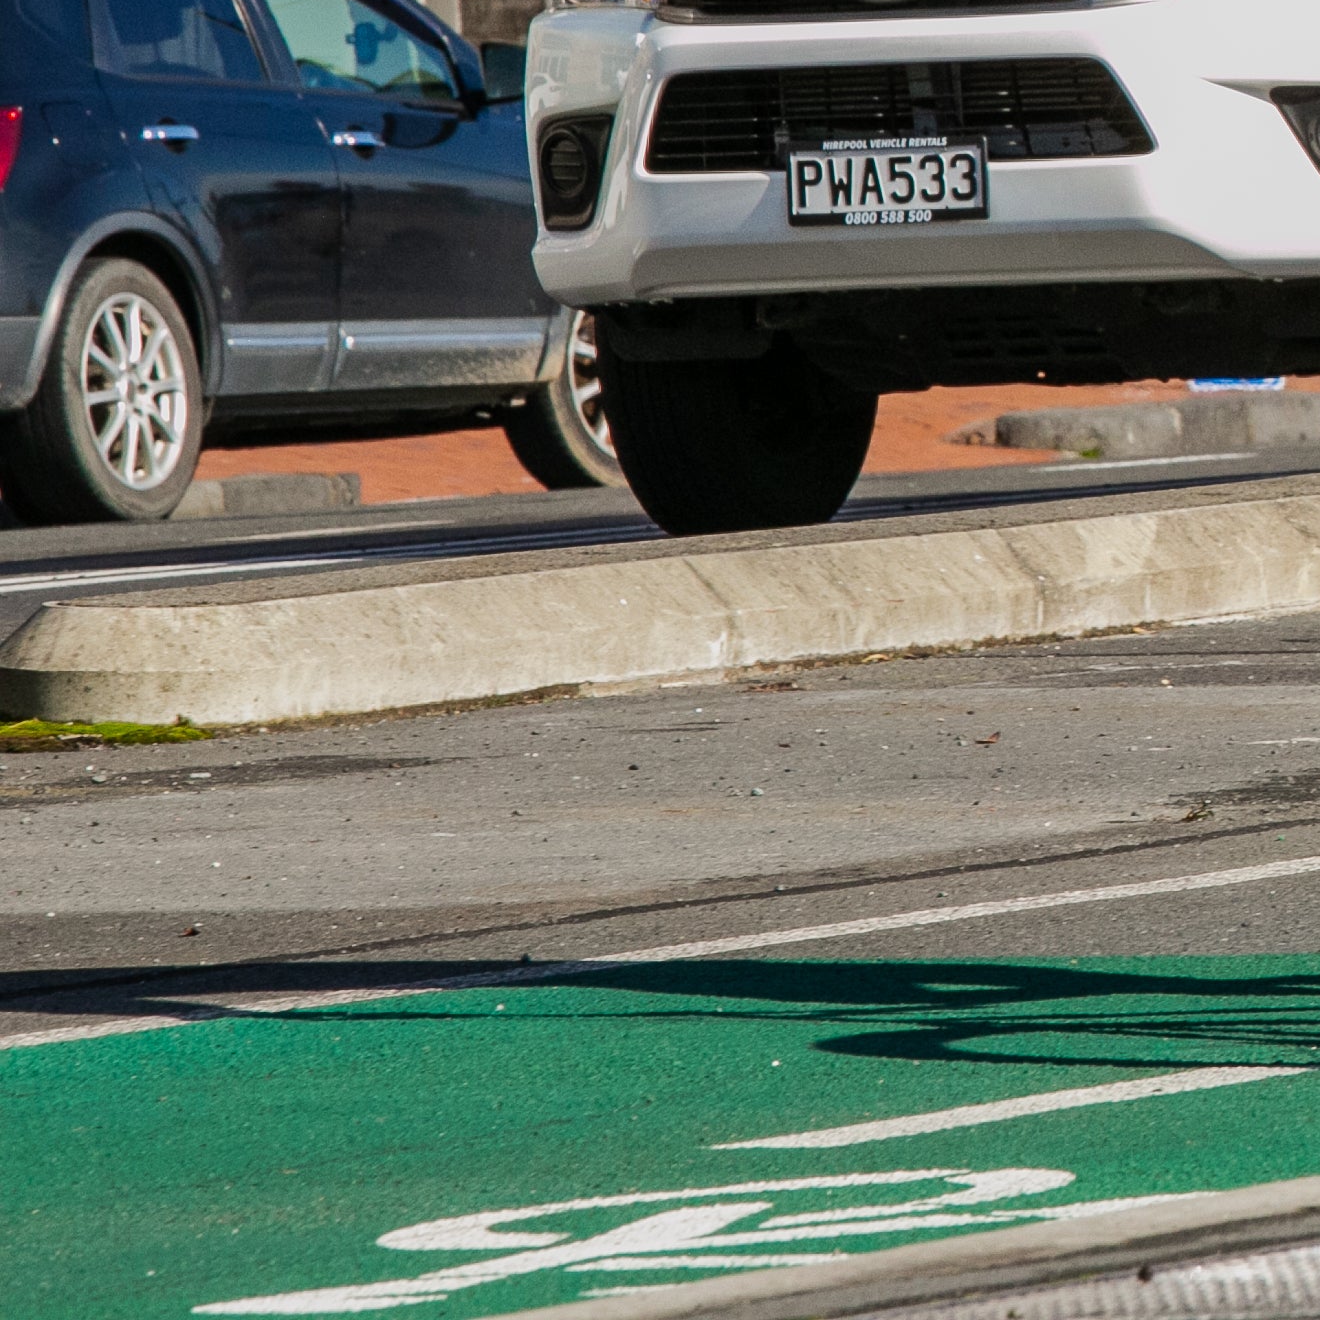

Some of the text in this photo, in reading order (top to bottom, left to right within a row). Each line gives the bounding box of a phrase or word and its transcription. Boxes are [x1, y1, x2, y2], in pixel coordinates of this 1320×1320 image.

[823, 136, 948, 151] HIREPOOL VEHICLE RENTALS
[797, 153, 978, 207] PWA533
[845, 209, 932, 225] 0800 588 500
